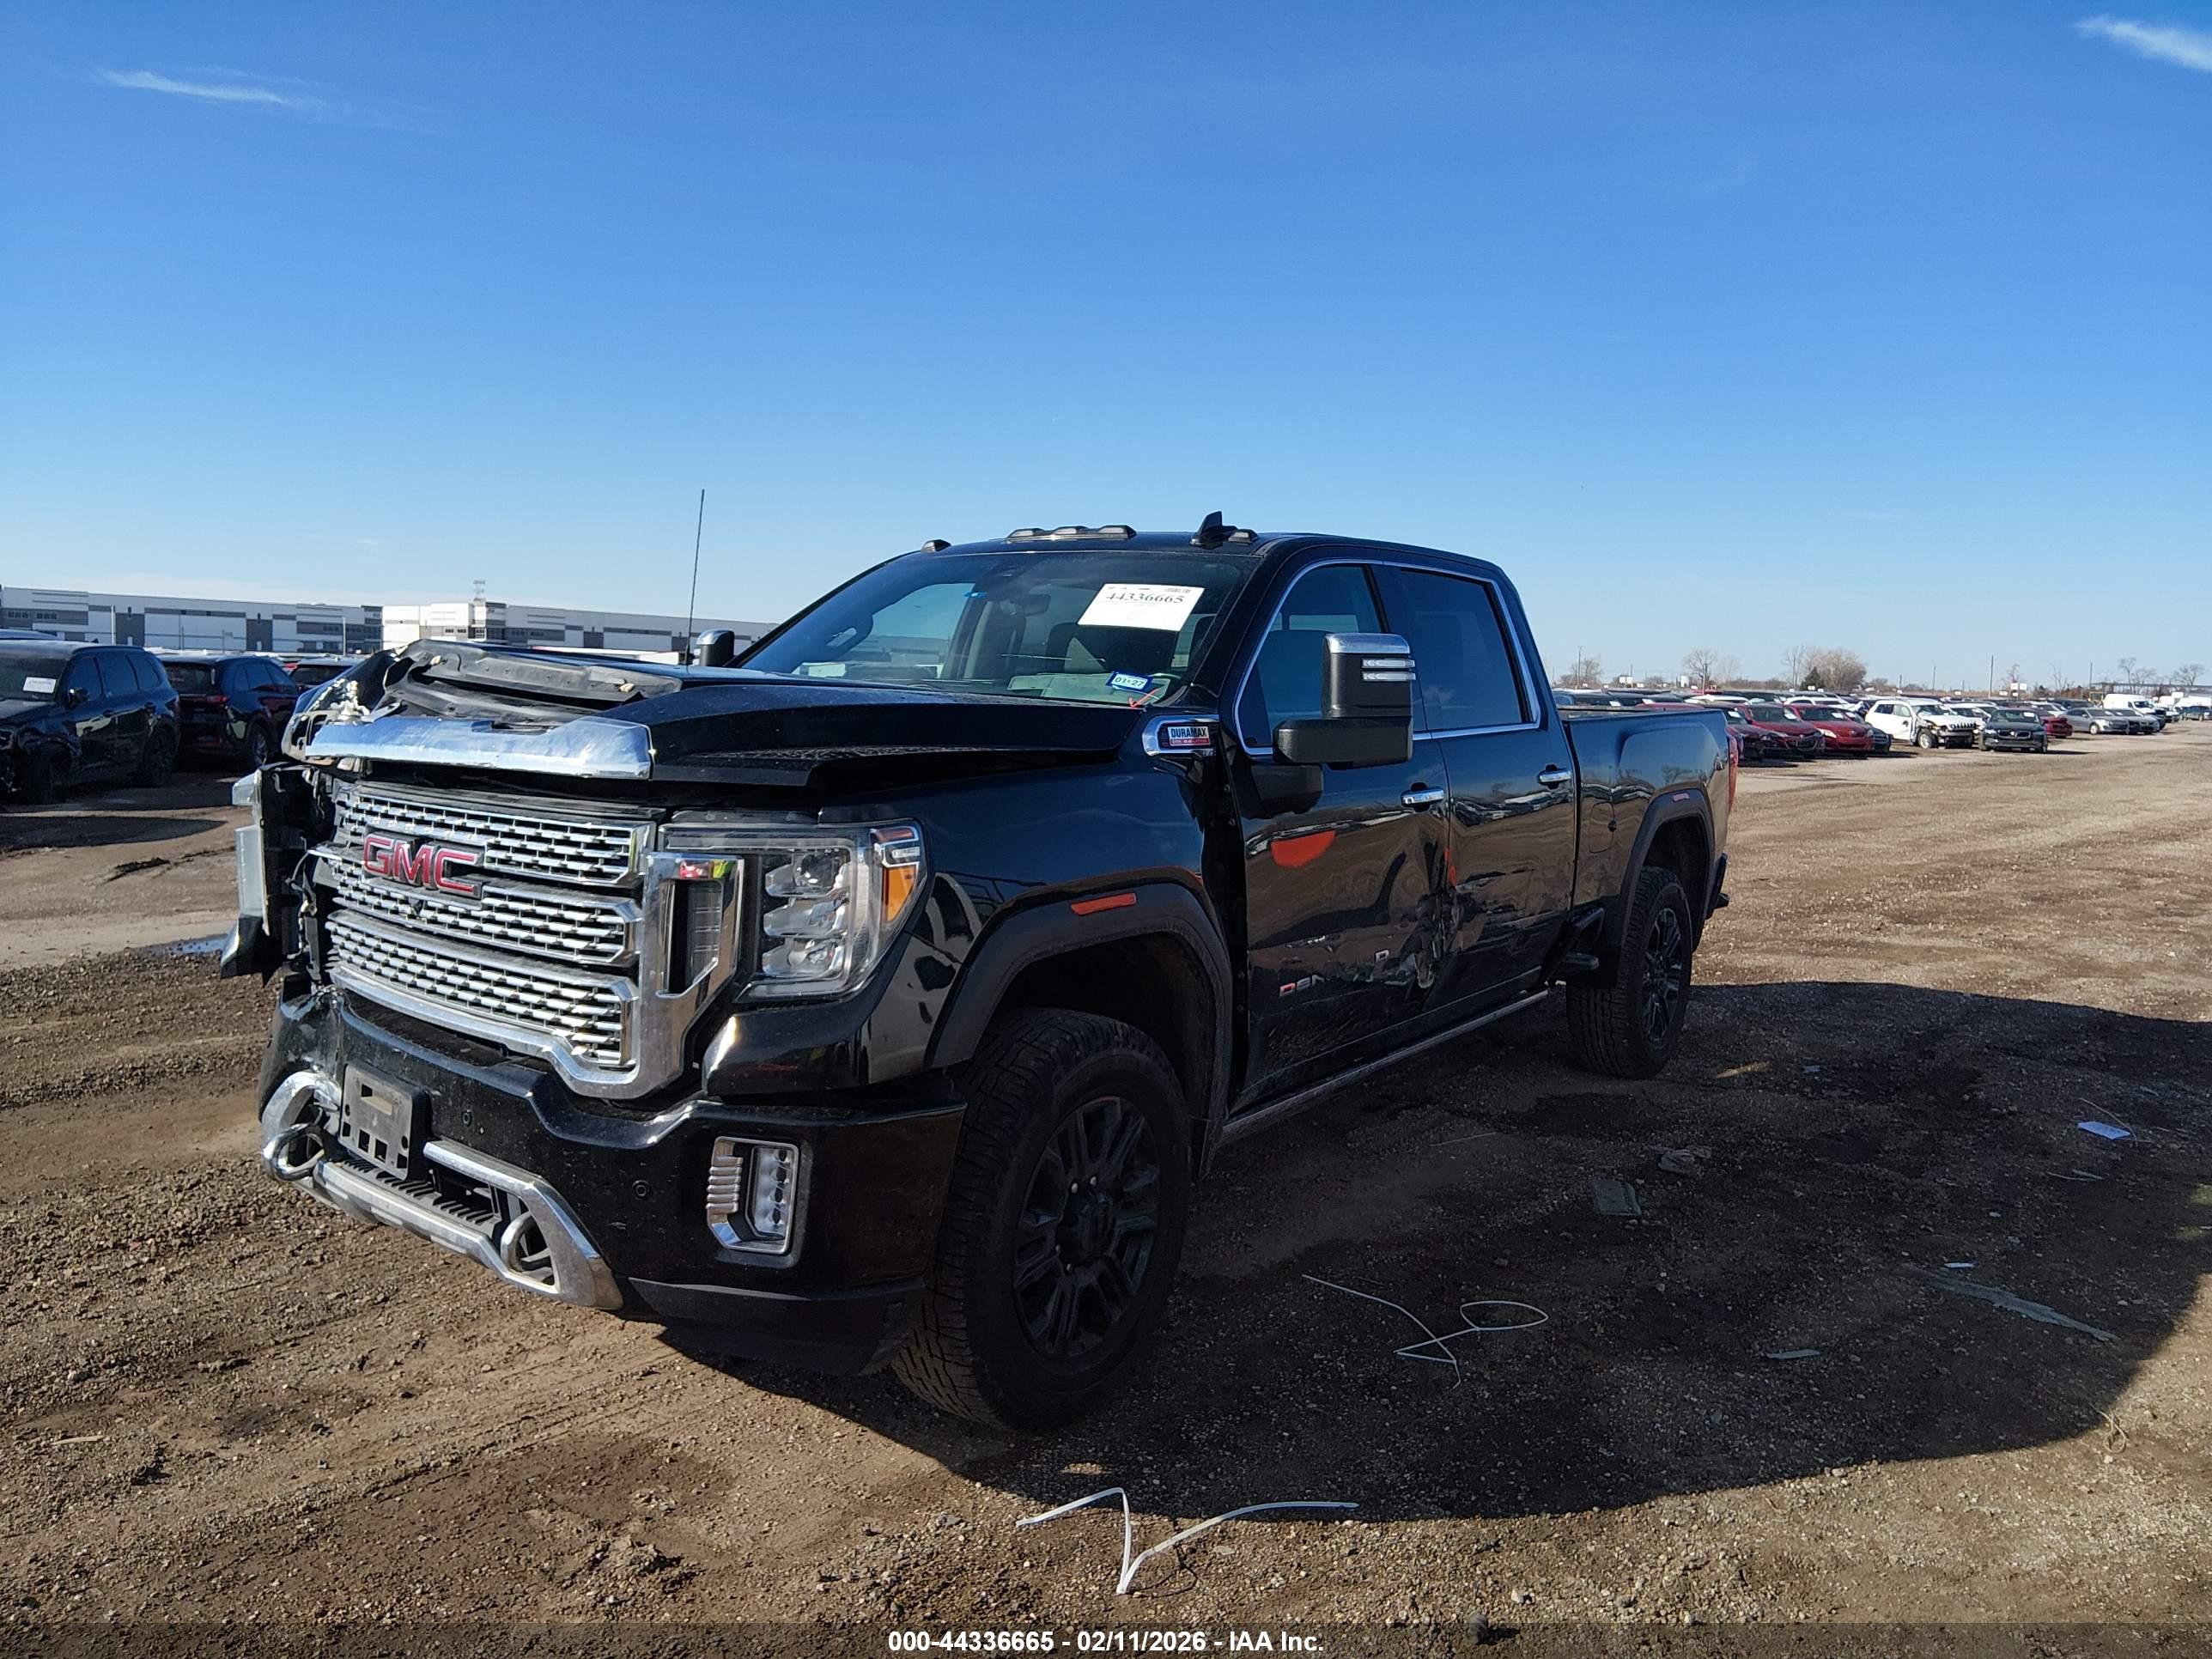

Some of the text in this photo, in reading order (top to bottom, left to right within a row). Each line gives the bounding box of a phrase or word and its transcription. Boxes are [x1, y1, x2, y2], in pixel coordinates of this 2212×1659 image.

[1105, 592, 1185, 604] 44336665
[1170, 726, 1207, 738] DURAMAX
[363, 834, 479, 896] GMC
